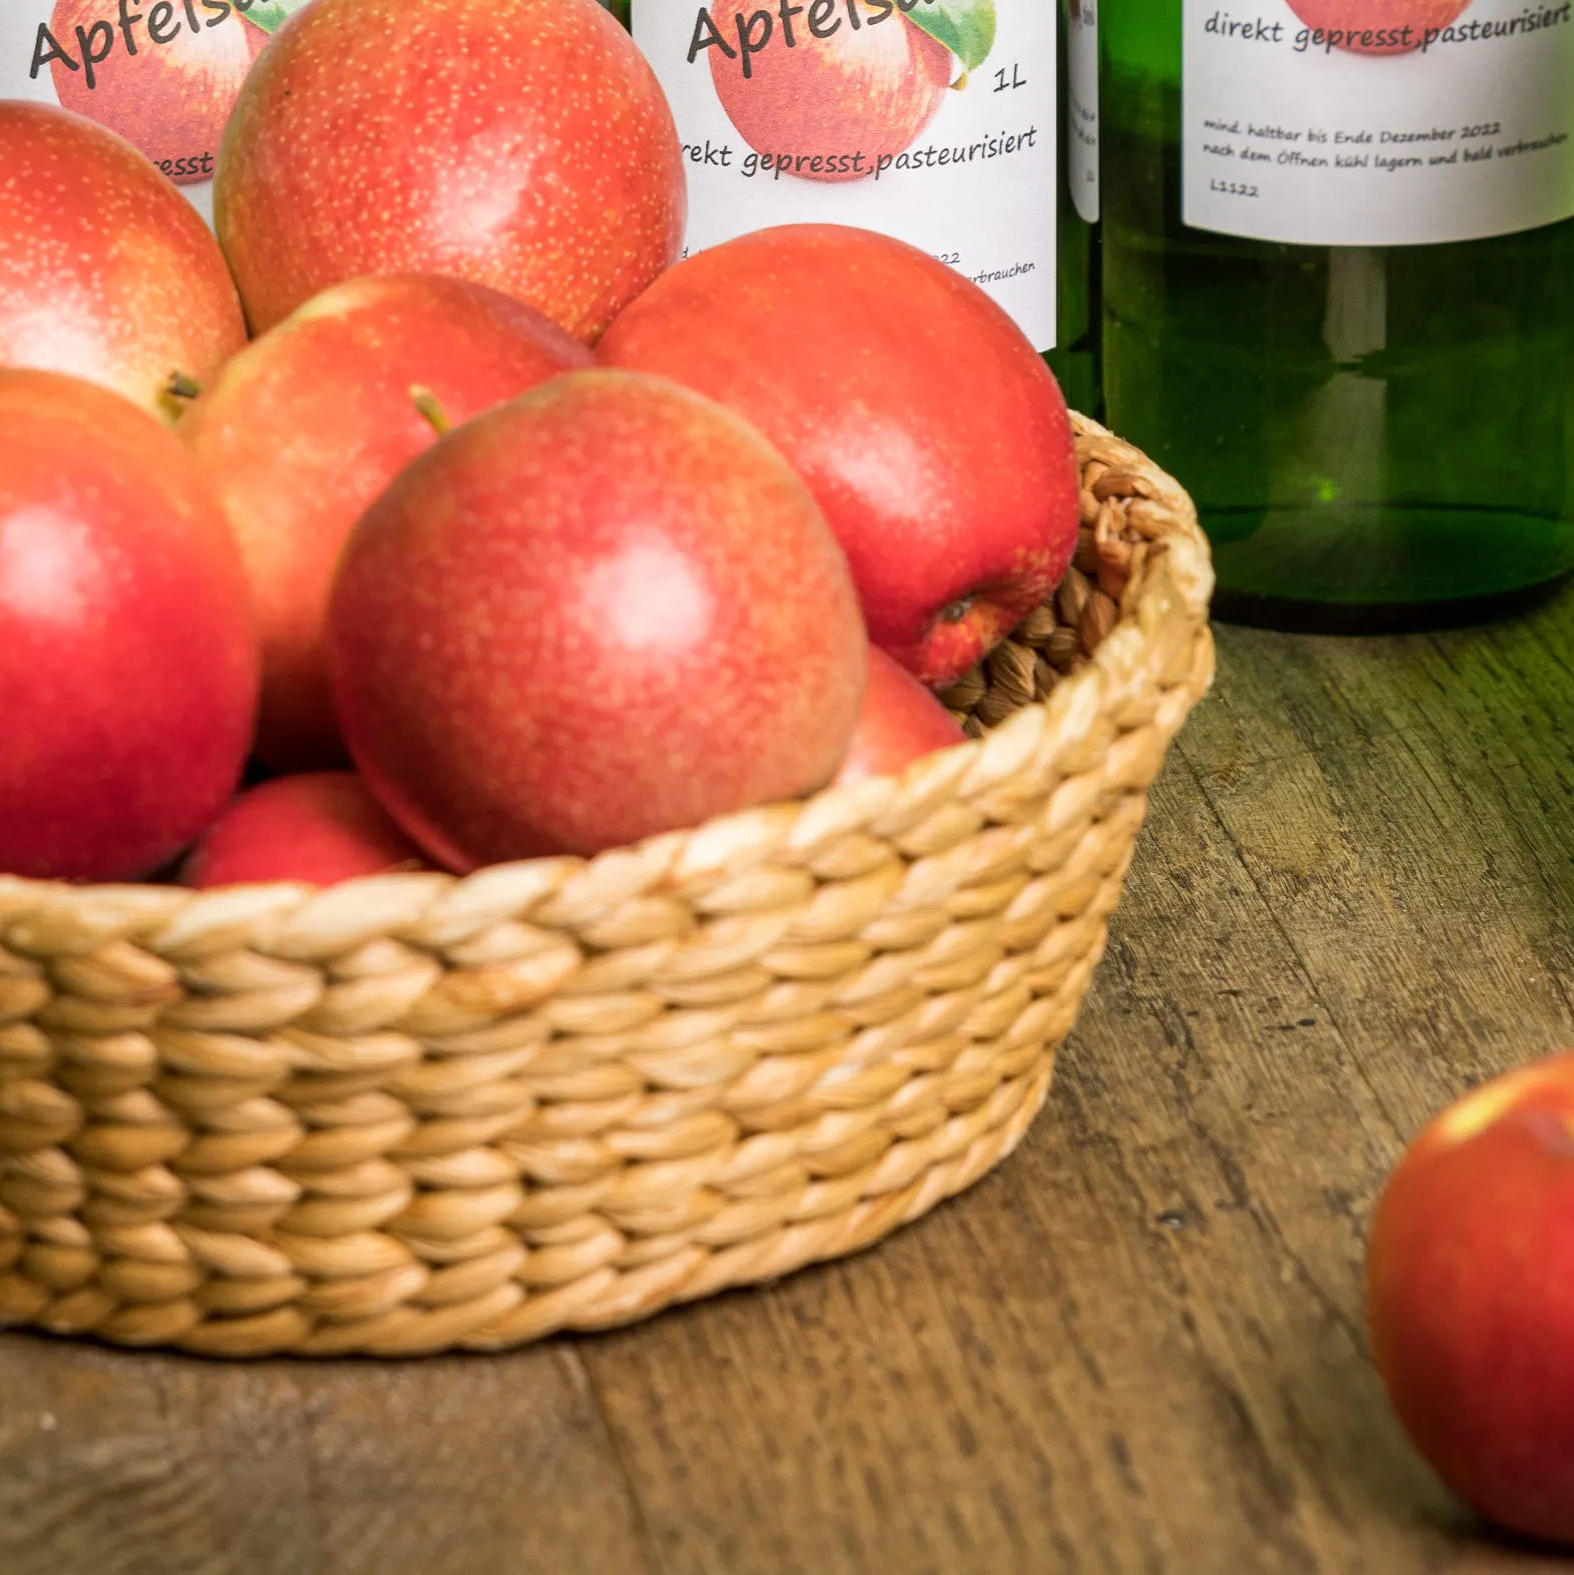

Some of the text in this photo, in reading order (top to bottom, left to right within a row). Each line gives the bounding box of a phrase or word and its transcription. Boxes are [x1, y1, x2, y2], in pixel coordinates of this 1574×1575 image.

[1204, 10, 1284, 43] direkt
[993, 62, 1027, 93] 1L
[680, 139, 733, 167] rekt
[967, 262, 1036, 284] rbrauchen
